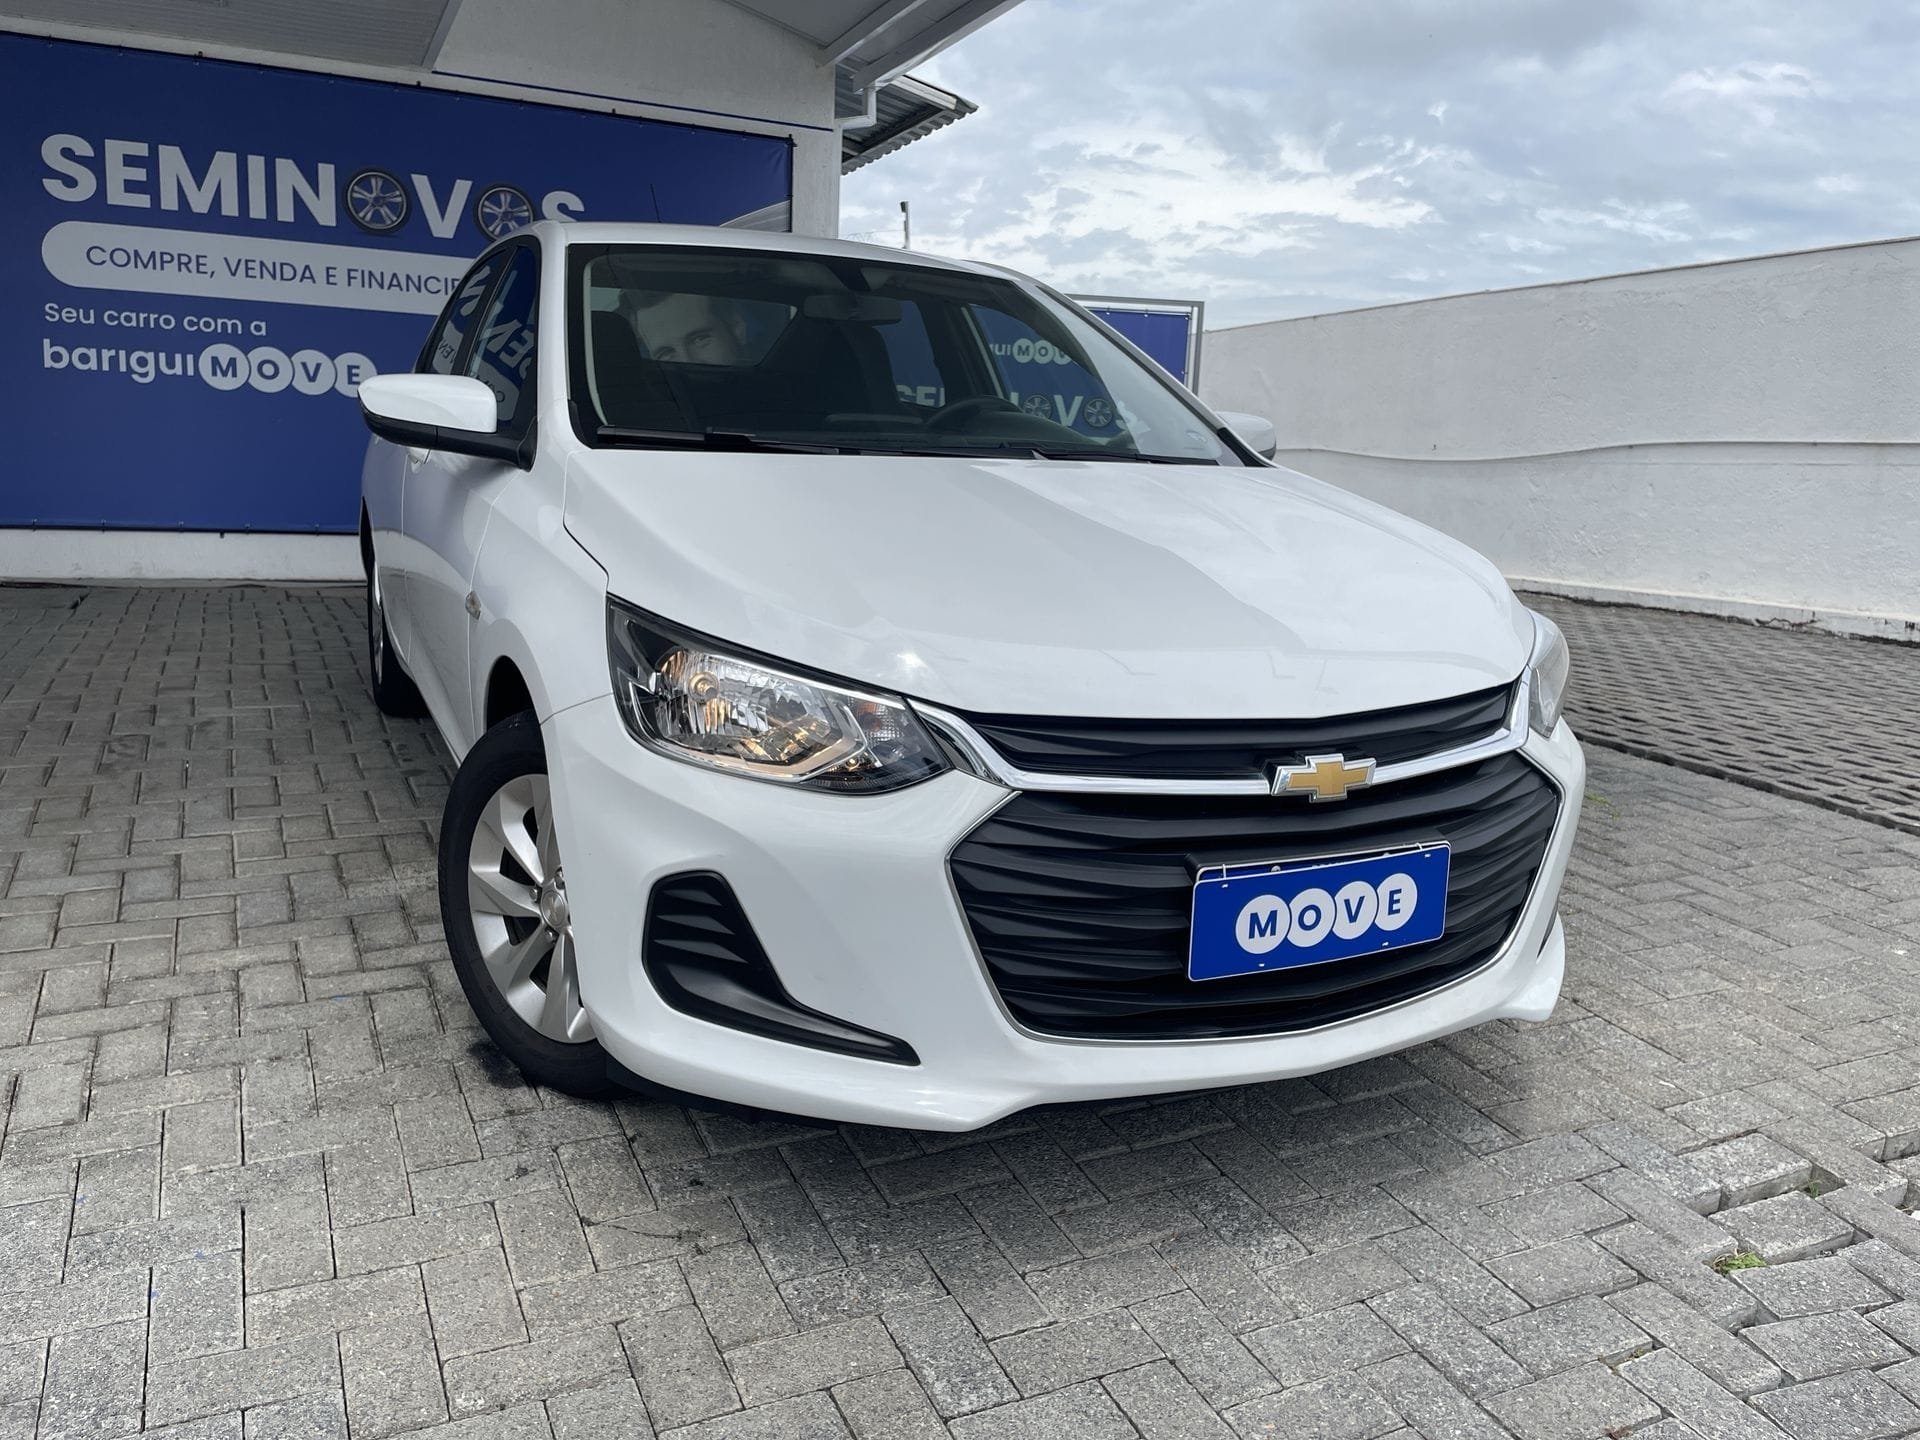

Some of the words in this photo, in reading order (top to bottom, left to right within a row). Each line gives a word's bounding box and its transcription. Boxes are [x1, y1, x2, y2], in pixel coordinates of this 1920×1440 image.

[86, 245, 215, 279] COMPRE,
[223, 256, 317, 285] VENDA
[325, 266, 338, 287] E
[44, 302, 96, 325] Seu
[103, 309, 176, 330] carro
[183, 316, 242, 335] com
[250, 320, 267, 337] a
[1246, 886, 1404, 940] MOVE
